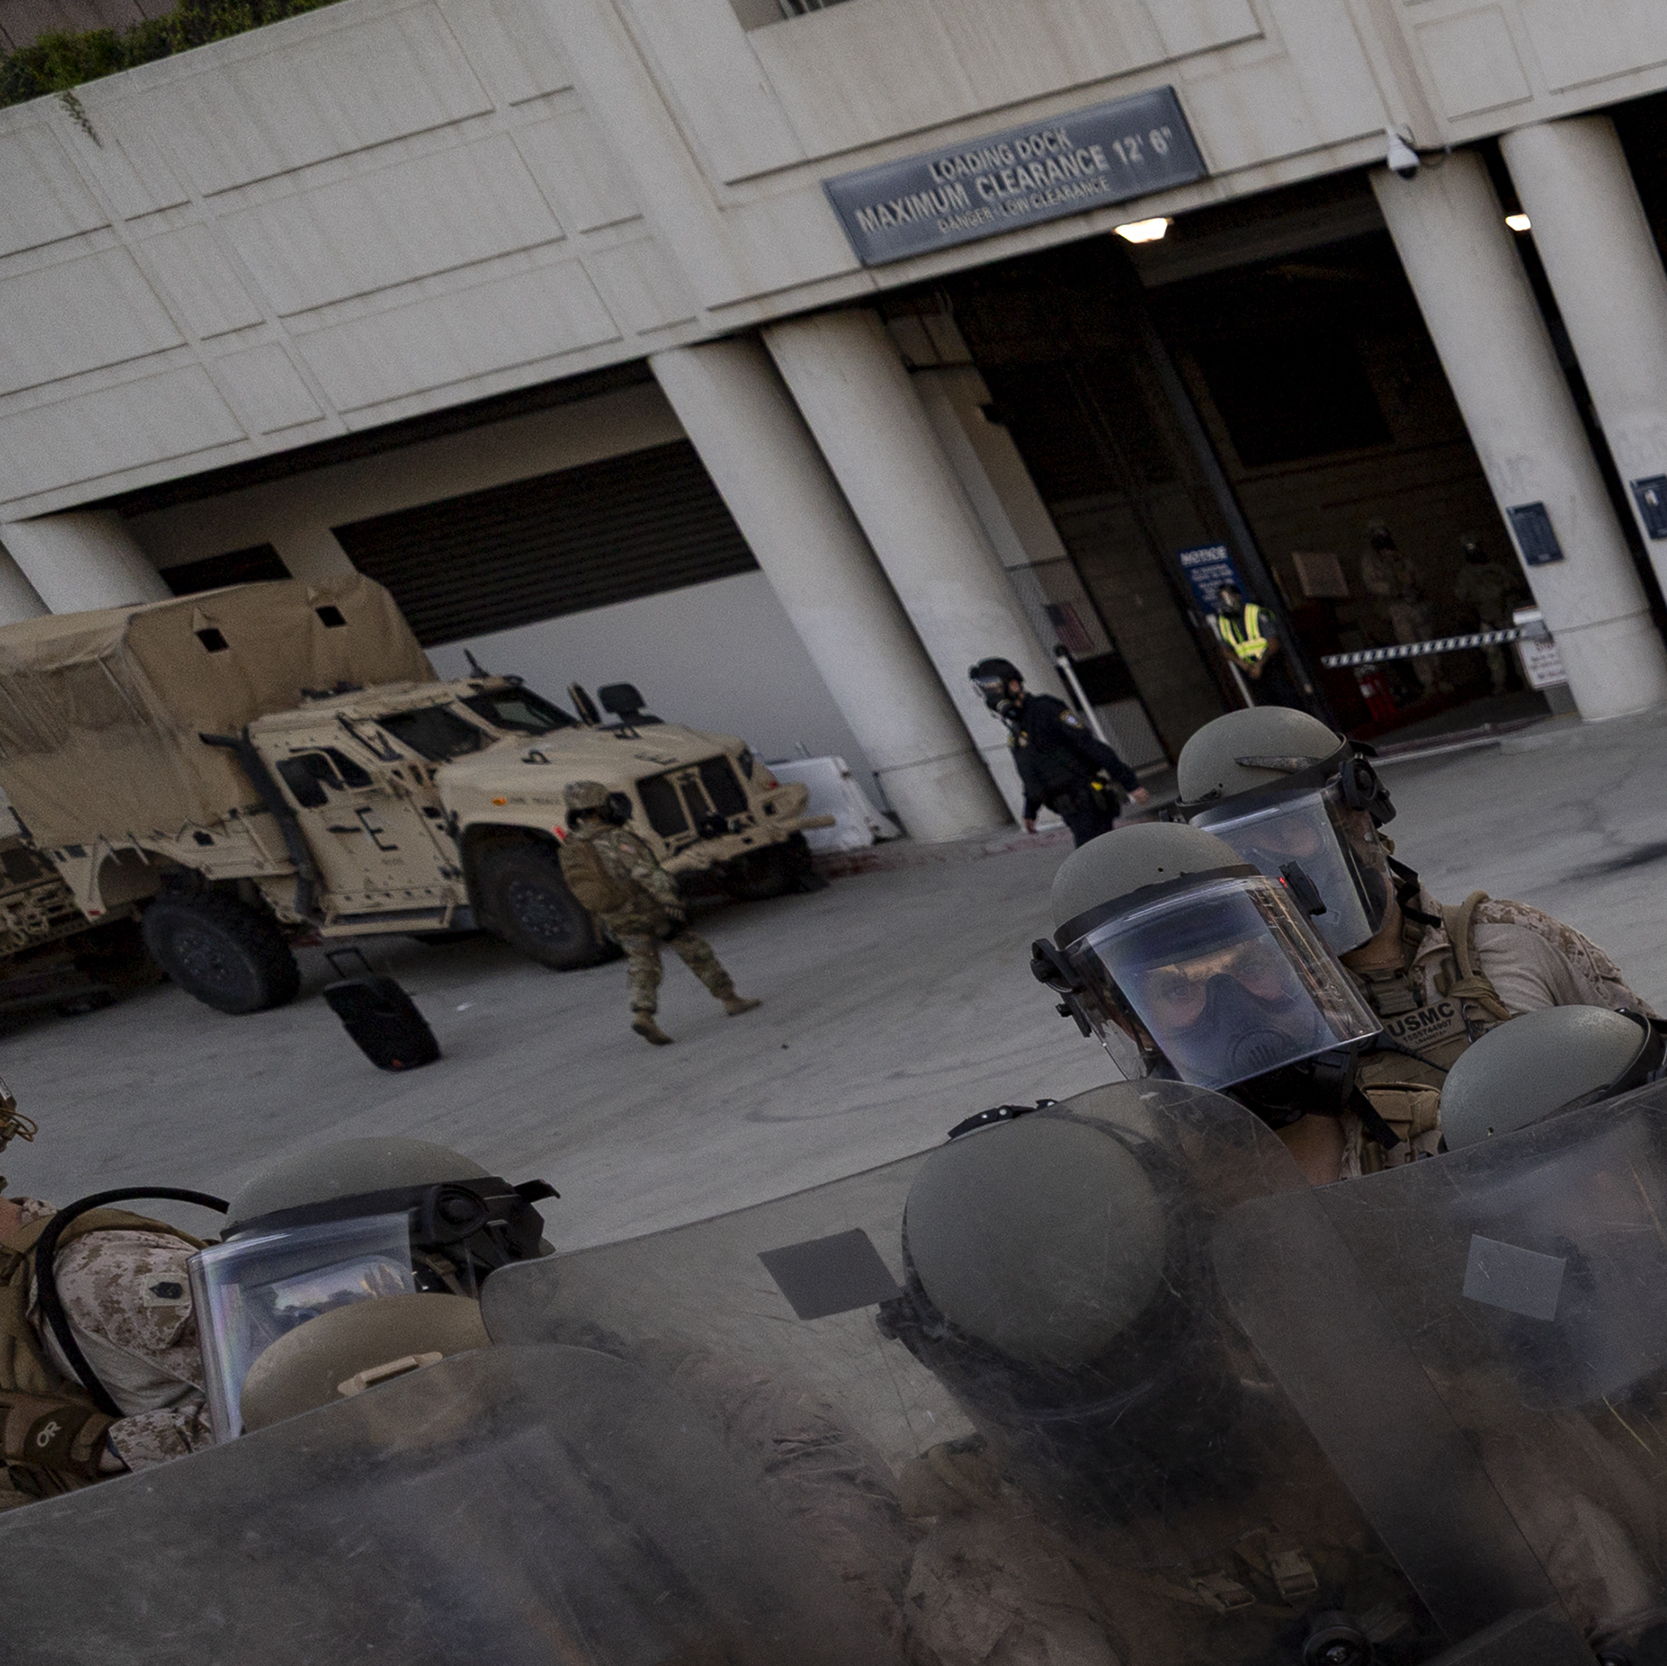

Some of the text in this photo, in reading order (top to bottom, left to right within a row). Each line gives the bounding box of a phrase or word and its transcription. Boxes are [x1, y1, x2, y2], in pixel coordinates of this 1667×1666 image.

[929, 128, 1071, 184] LOADING DOCK
[855, 185, 971, 234] MAXIMUM
[977, 144, 1109, 200] CLEARANCE
[937, 176, 1111, 234] DANGER LOW CLEARANCE
[1180, 545, 1228, 567] NOTICE
[1386, 1003, 1454, 1037] USMC
[36, 1421, 62, 1447] OR
